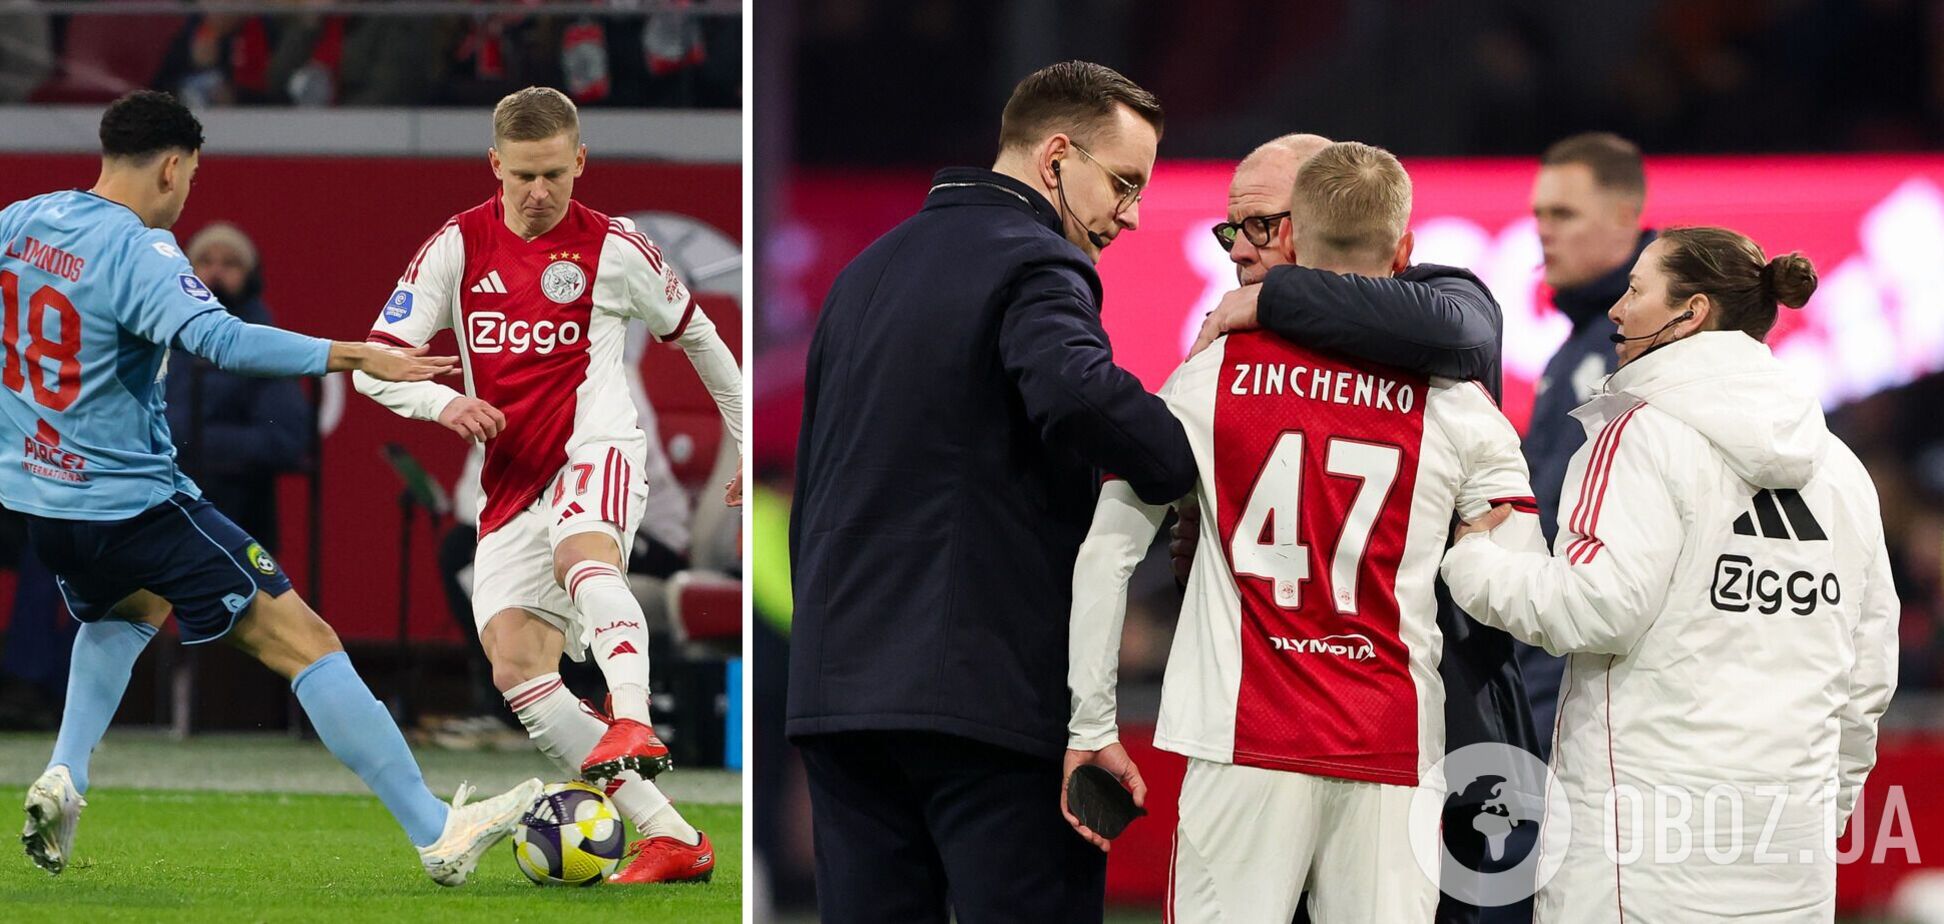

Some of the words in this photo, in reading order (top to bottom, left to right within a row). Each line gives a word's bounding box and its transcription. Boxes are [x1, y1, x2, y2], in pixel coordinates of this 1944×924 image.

[0, 269, 81, 412] 18
[468, 312, 580, 354] Ziggo
[1231, 364, 1414, 414] ZINCHENKO
[1229, 429, 1403, 615] 47
[1710, 553, 1841, 616] Ziggo
[594, 620, 640, 638] AJAX
